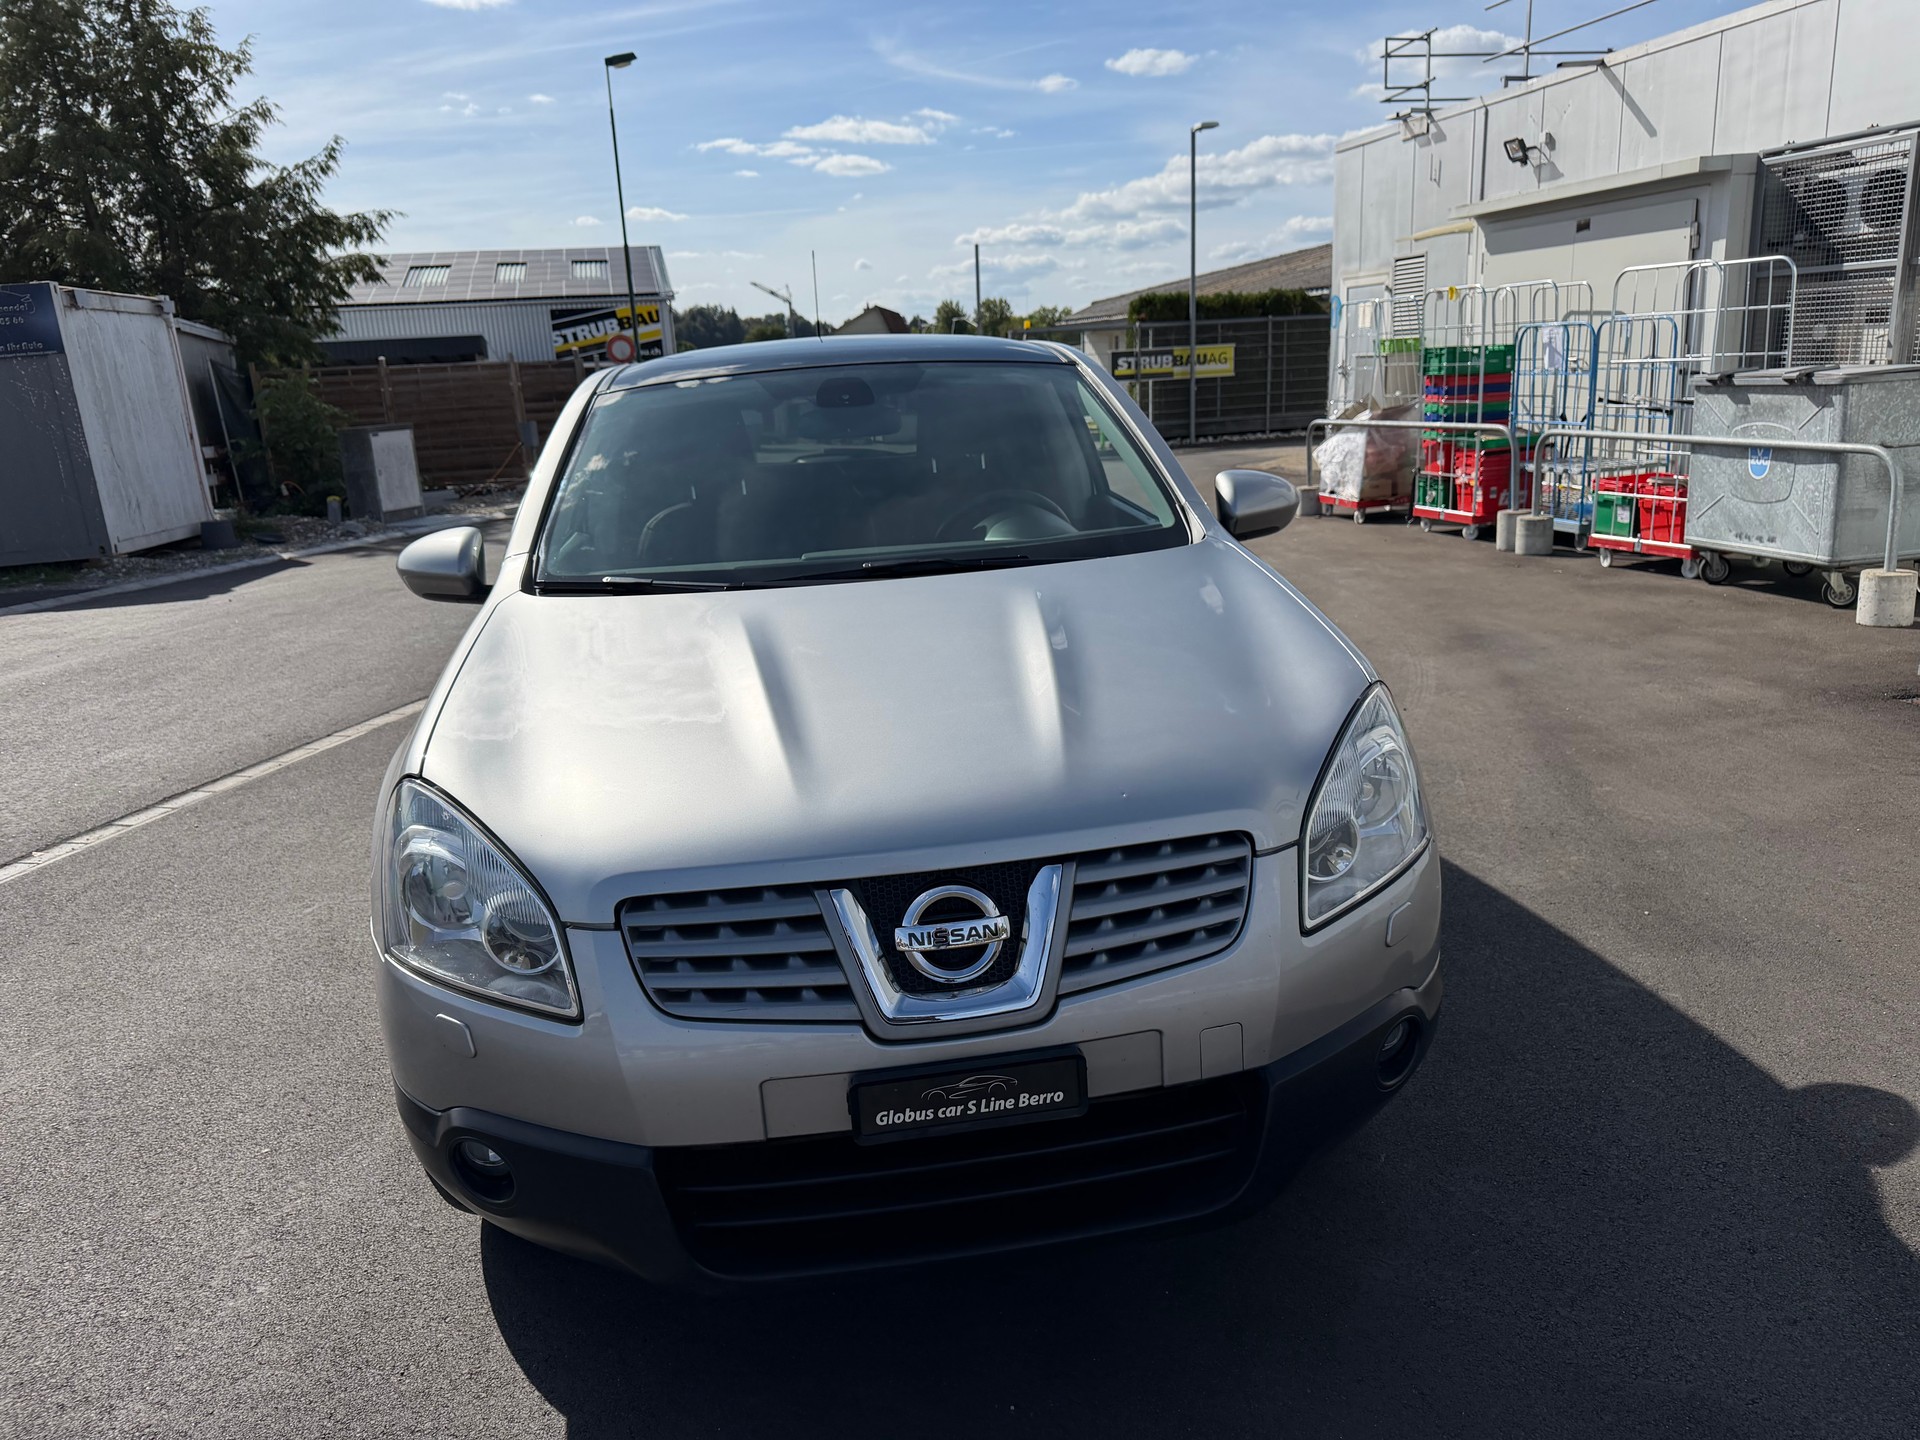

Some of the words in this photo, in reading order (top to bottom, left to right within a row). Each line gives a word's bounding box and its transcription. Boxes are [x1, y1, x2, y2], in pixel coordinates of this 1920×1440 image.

[1751, 455, 1769, 465] ZUG
[907, 921, 999, 948] NISSAN
[875, 1108, 935, 1127] Globus
[937, 1102, 964, 1118] car
[966, 1100, 977, 1115] S
[980, 1096, 1015, 1113] Line
[1018, 1091, 1065, 1108] Berro
